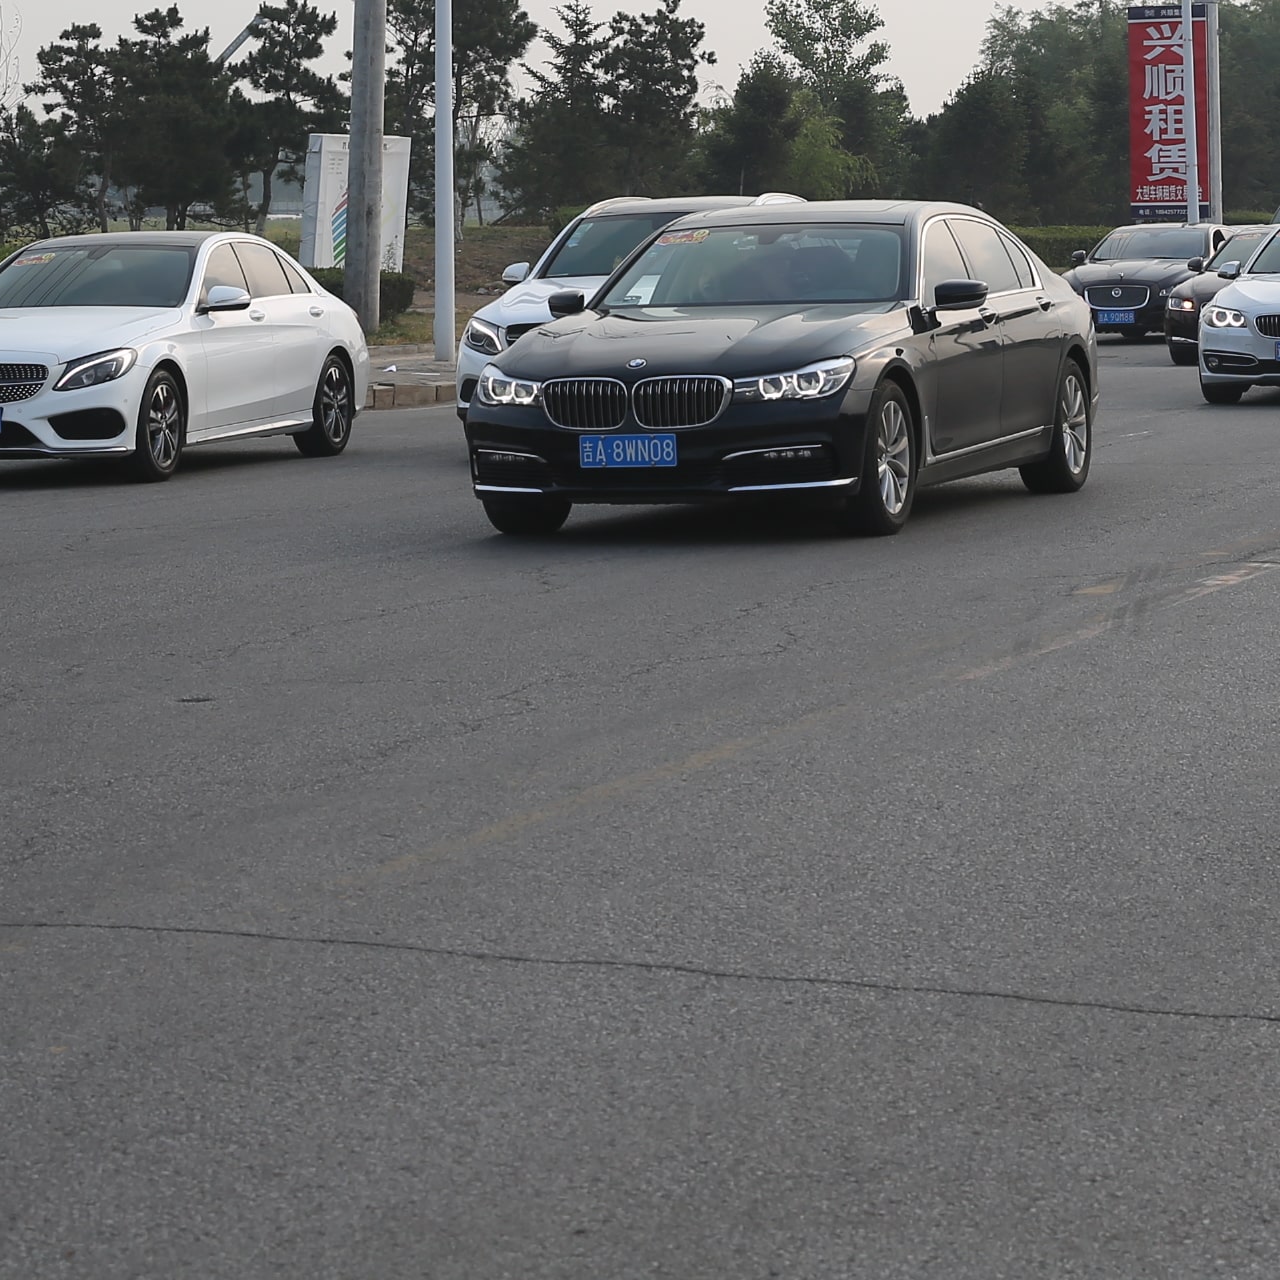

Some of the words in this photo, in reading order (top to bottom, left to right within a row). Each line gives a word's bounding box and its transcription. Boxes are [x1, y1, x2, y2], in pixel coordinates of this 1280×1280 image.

[1143, 23, 1188, 182] 兴顺租赁
[1136, 185, 1203, 201] 大型车辆租赁交易台
